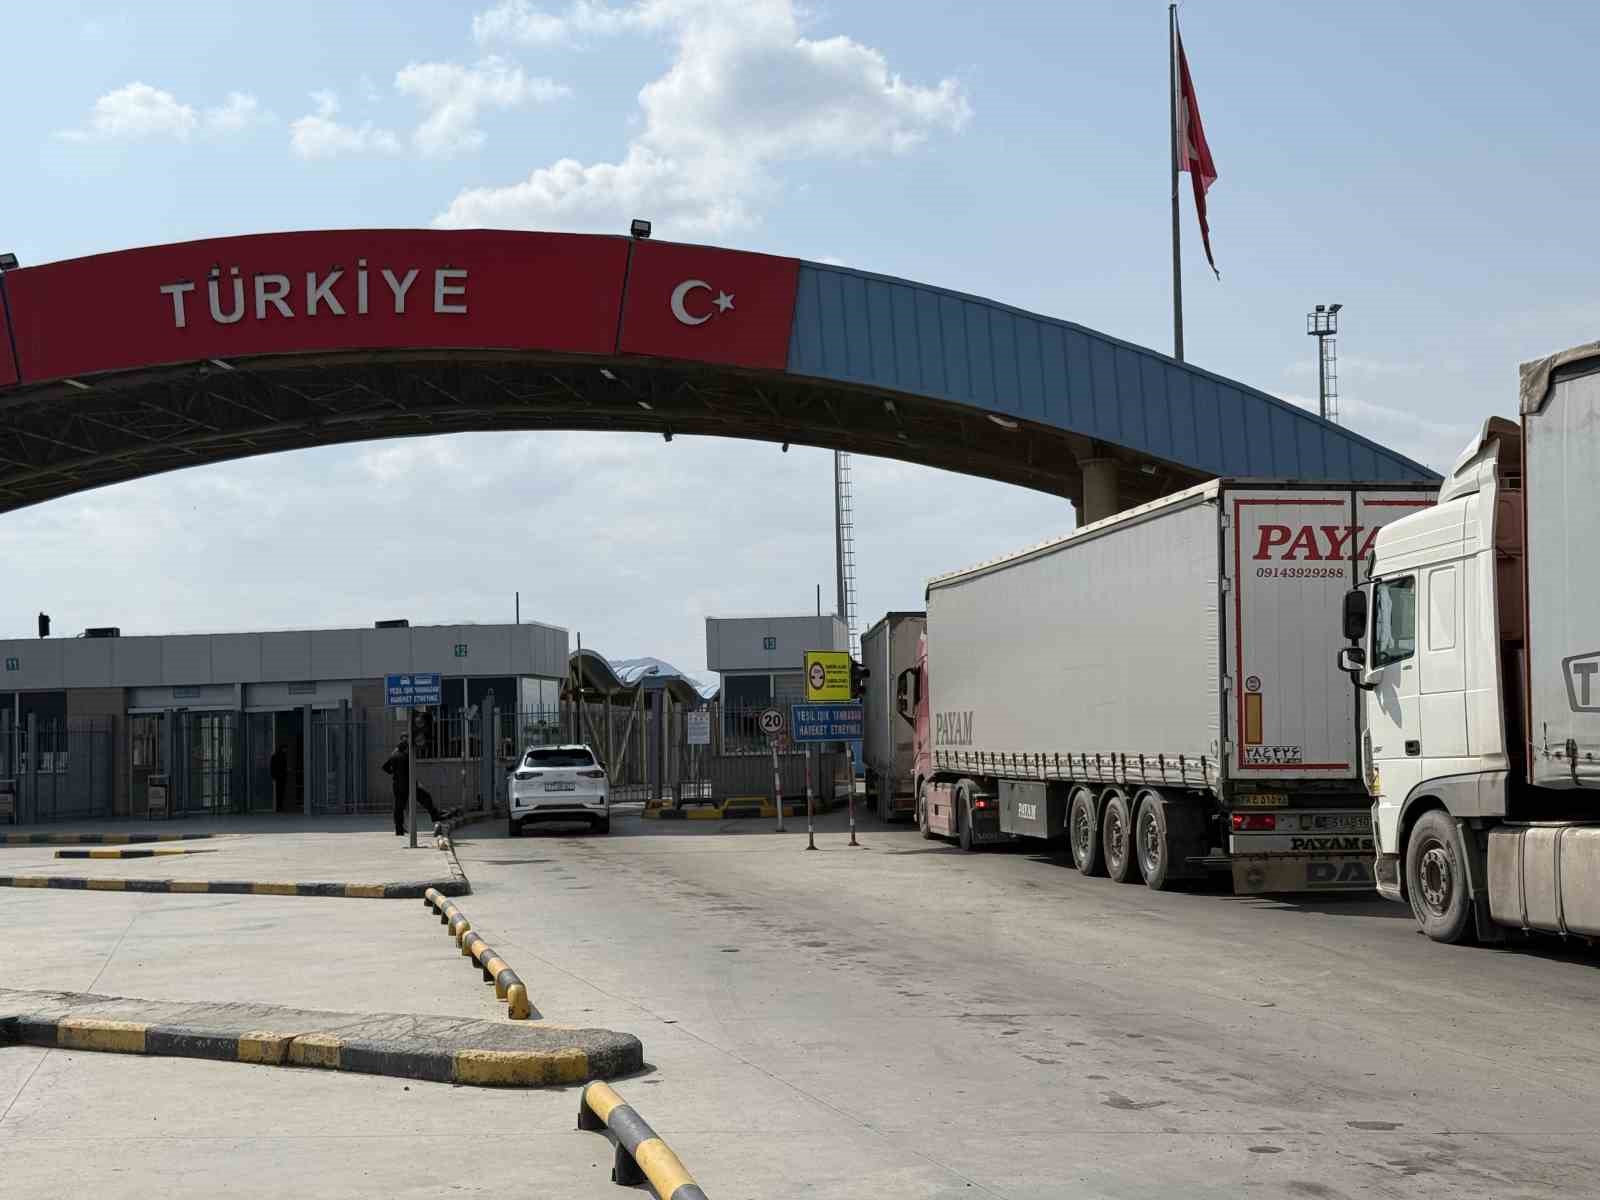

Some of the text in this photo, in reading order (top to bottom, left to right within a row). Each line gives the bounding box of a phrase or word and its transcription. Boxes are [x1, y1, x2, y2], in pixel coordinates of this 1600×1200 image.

[160, 257, 469, 329] TÜRKİYE
[765, 714, 779, 727] 20
[936, 711, 974, 745] PAYAM
